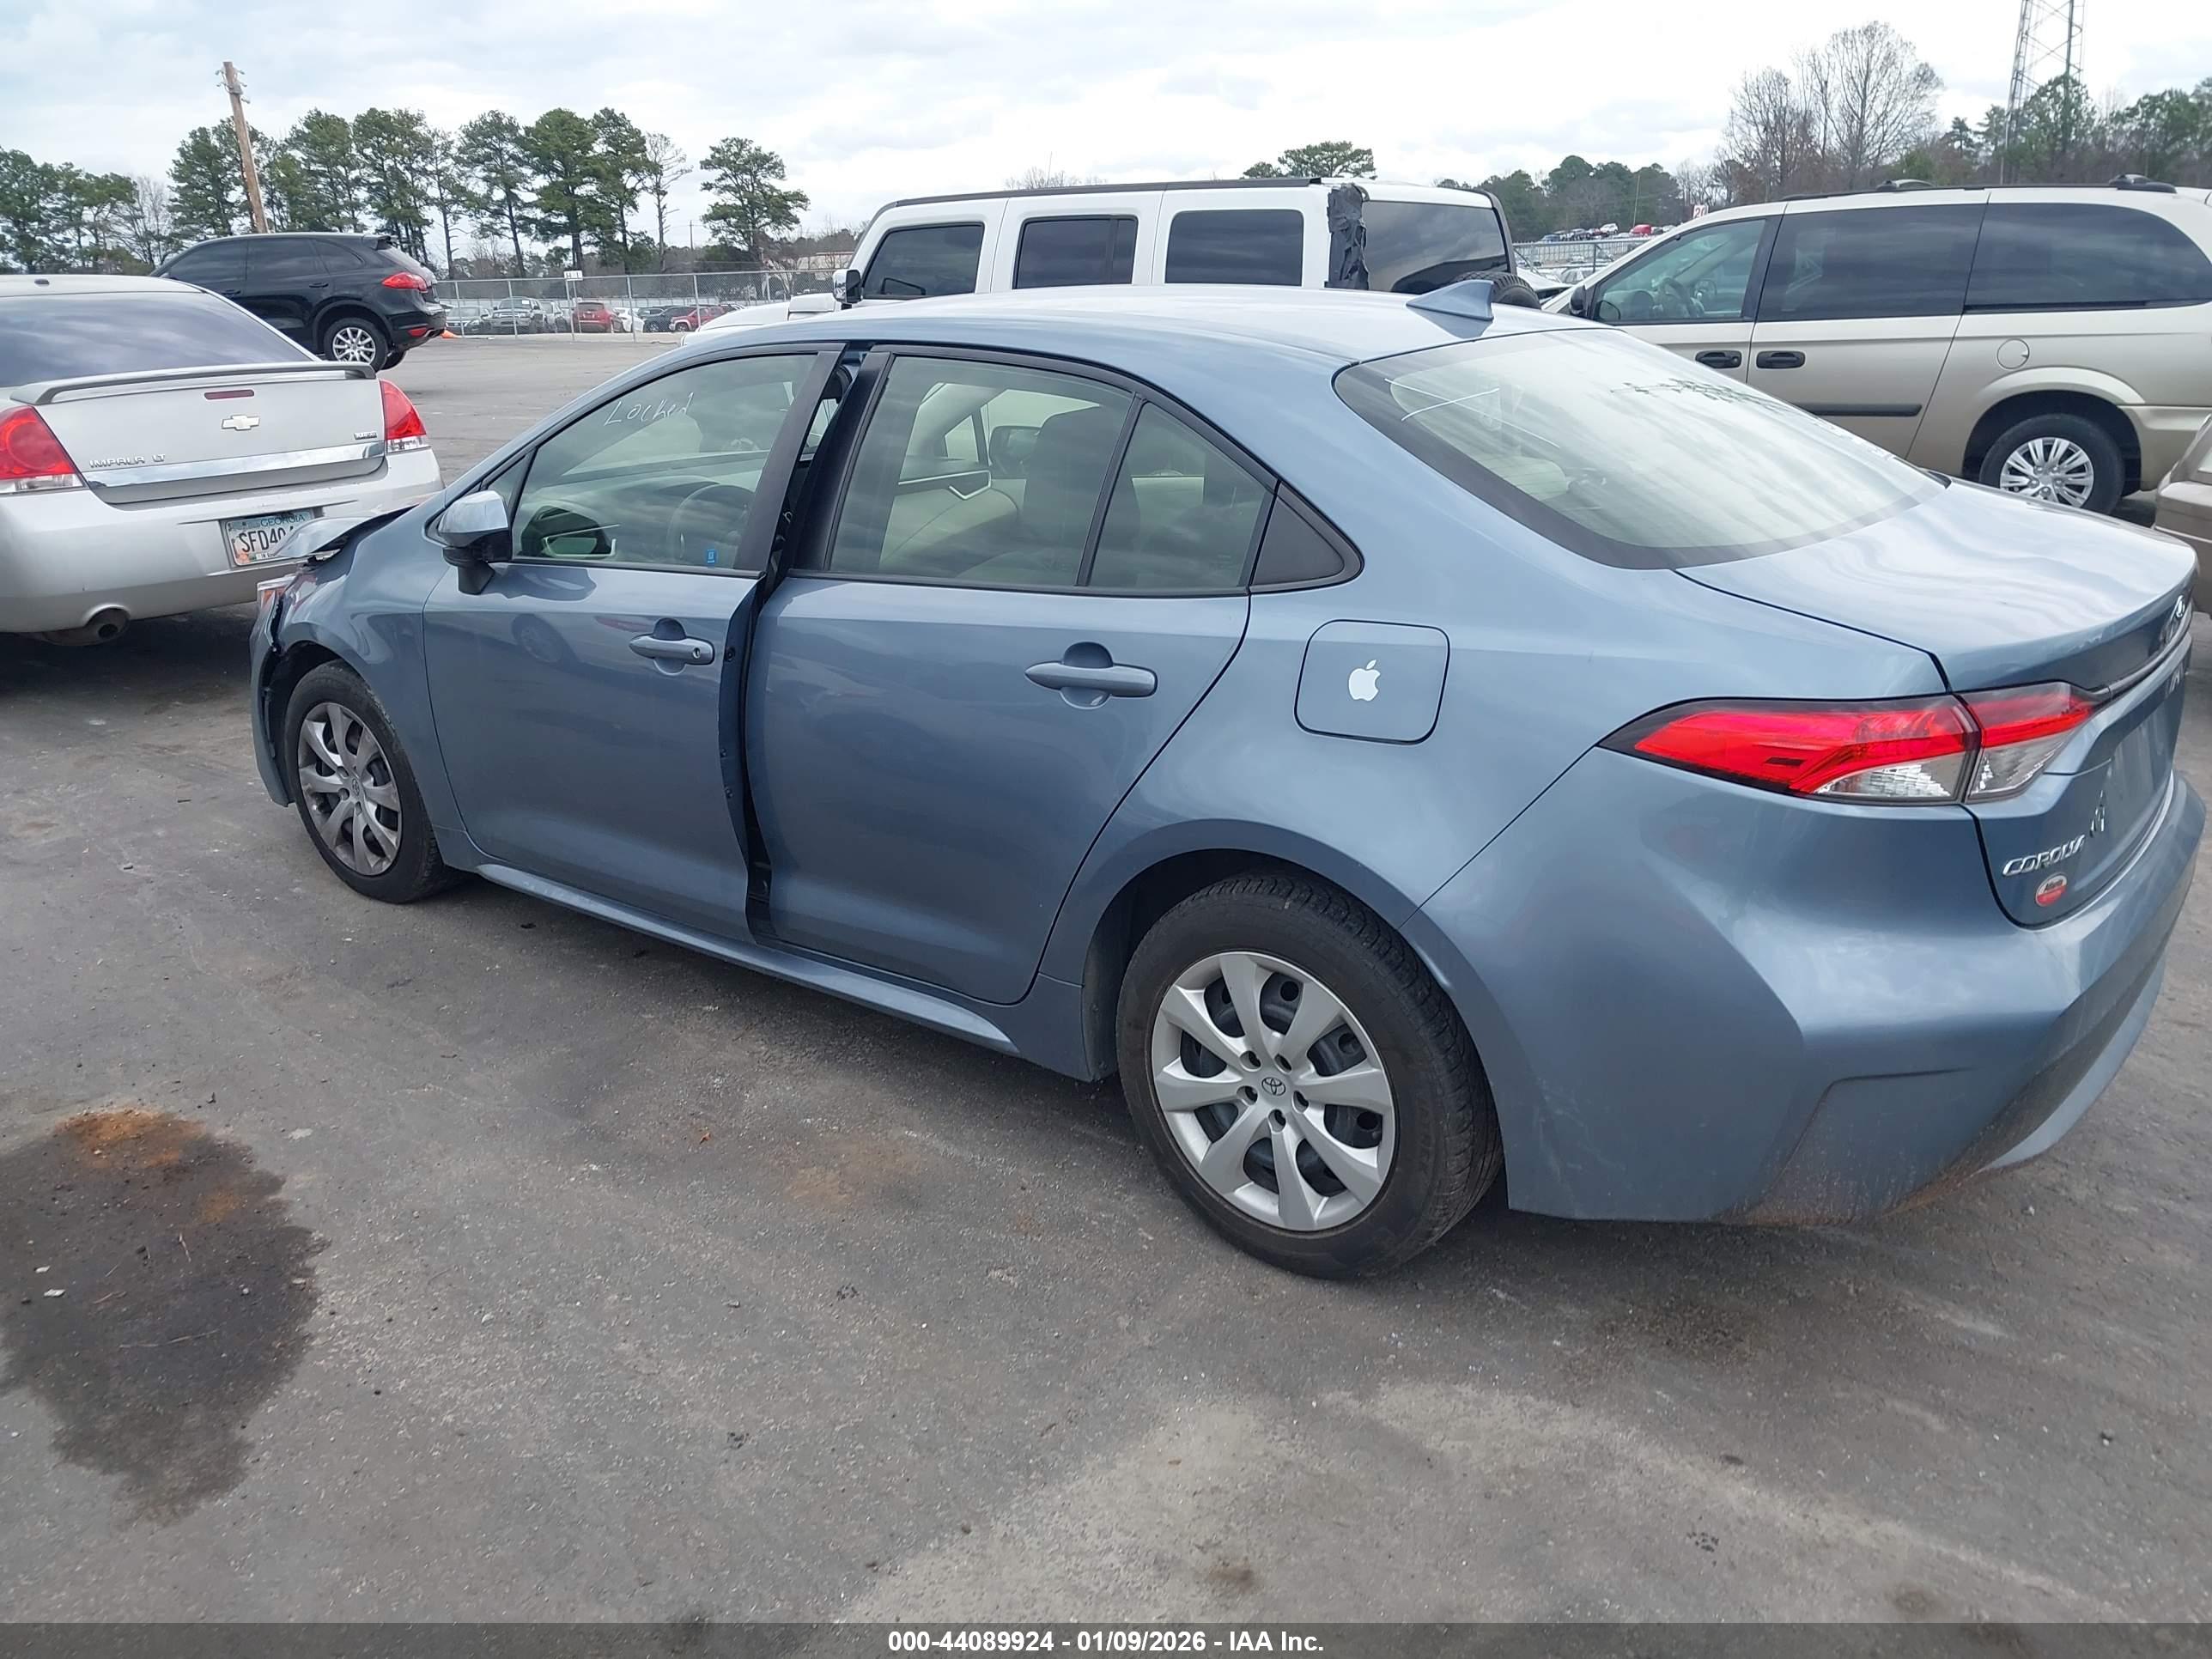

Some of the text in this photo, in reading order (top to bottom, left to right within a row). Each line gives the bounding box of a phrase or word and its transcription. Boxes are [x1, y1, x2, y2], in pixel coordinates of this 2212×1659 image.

[604, 392, 694, 427] Locked
[89, 453, 166, 468] IMPALA LT
[260, 514, 305, 527] GEORGIA
[239, 526, 294, 553] SFD40
[2002, 834, 2086, 876] COROLLA
